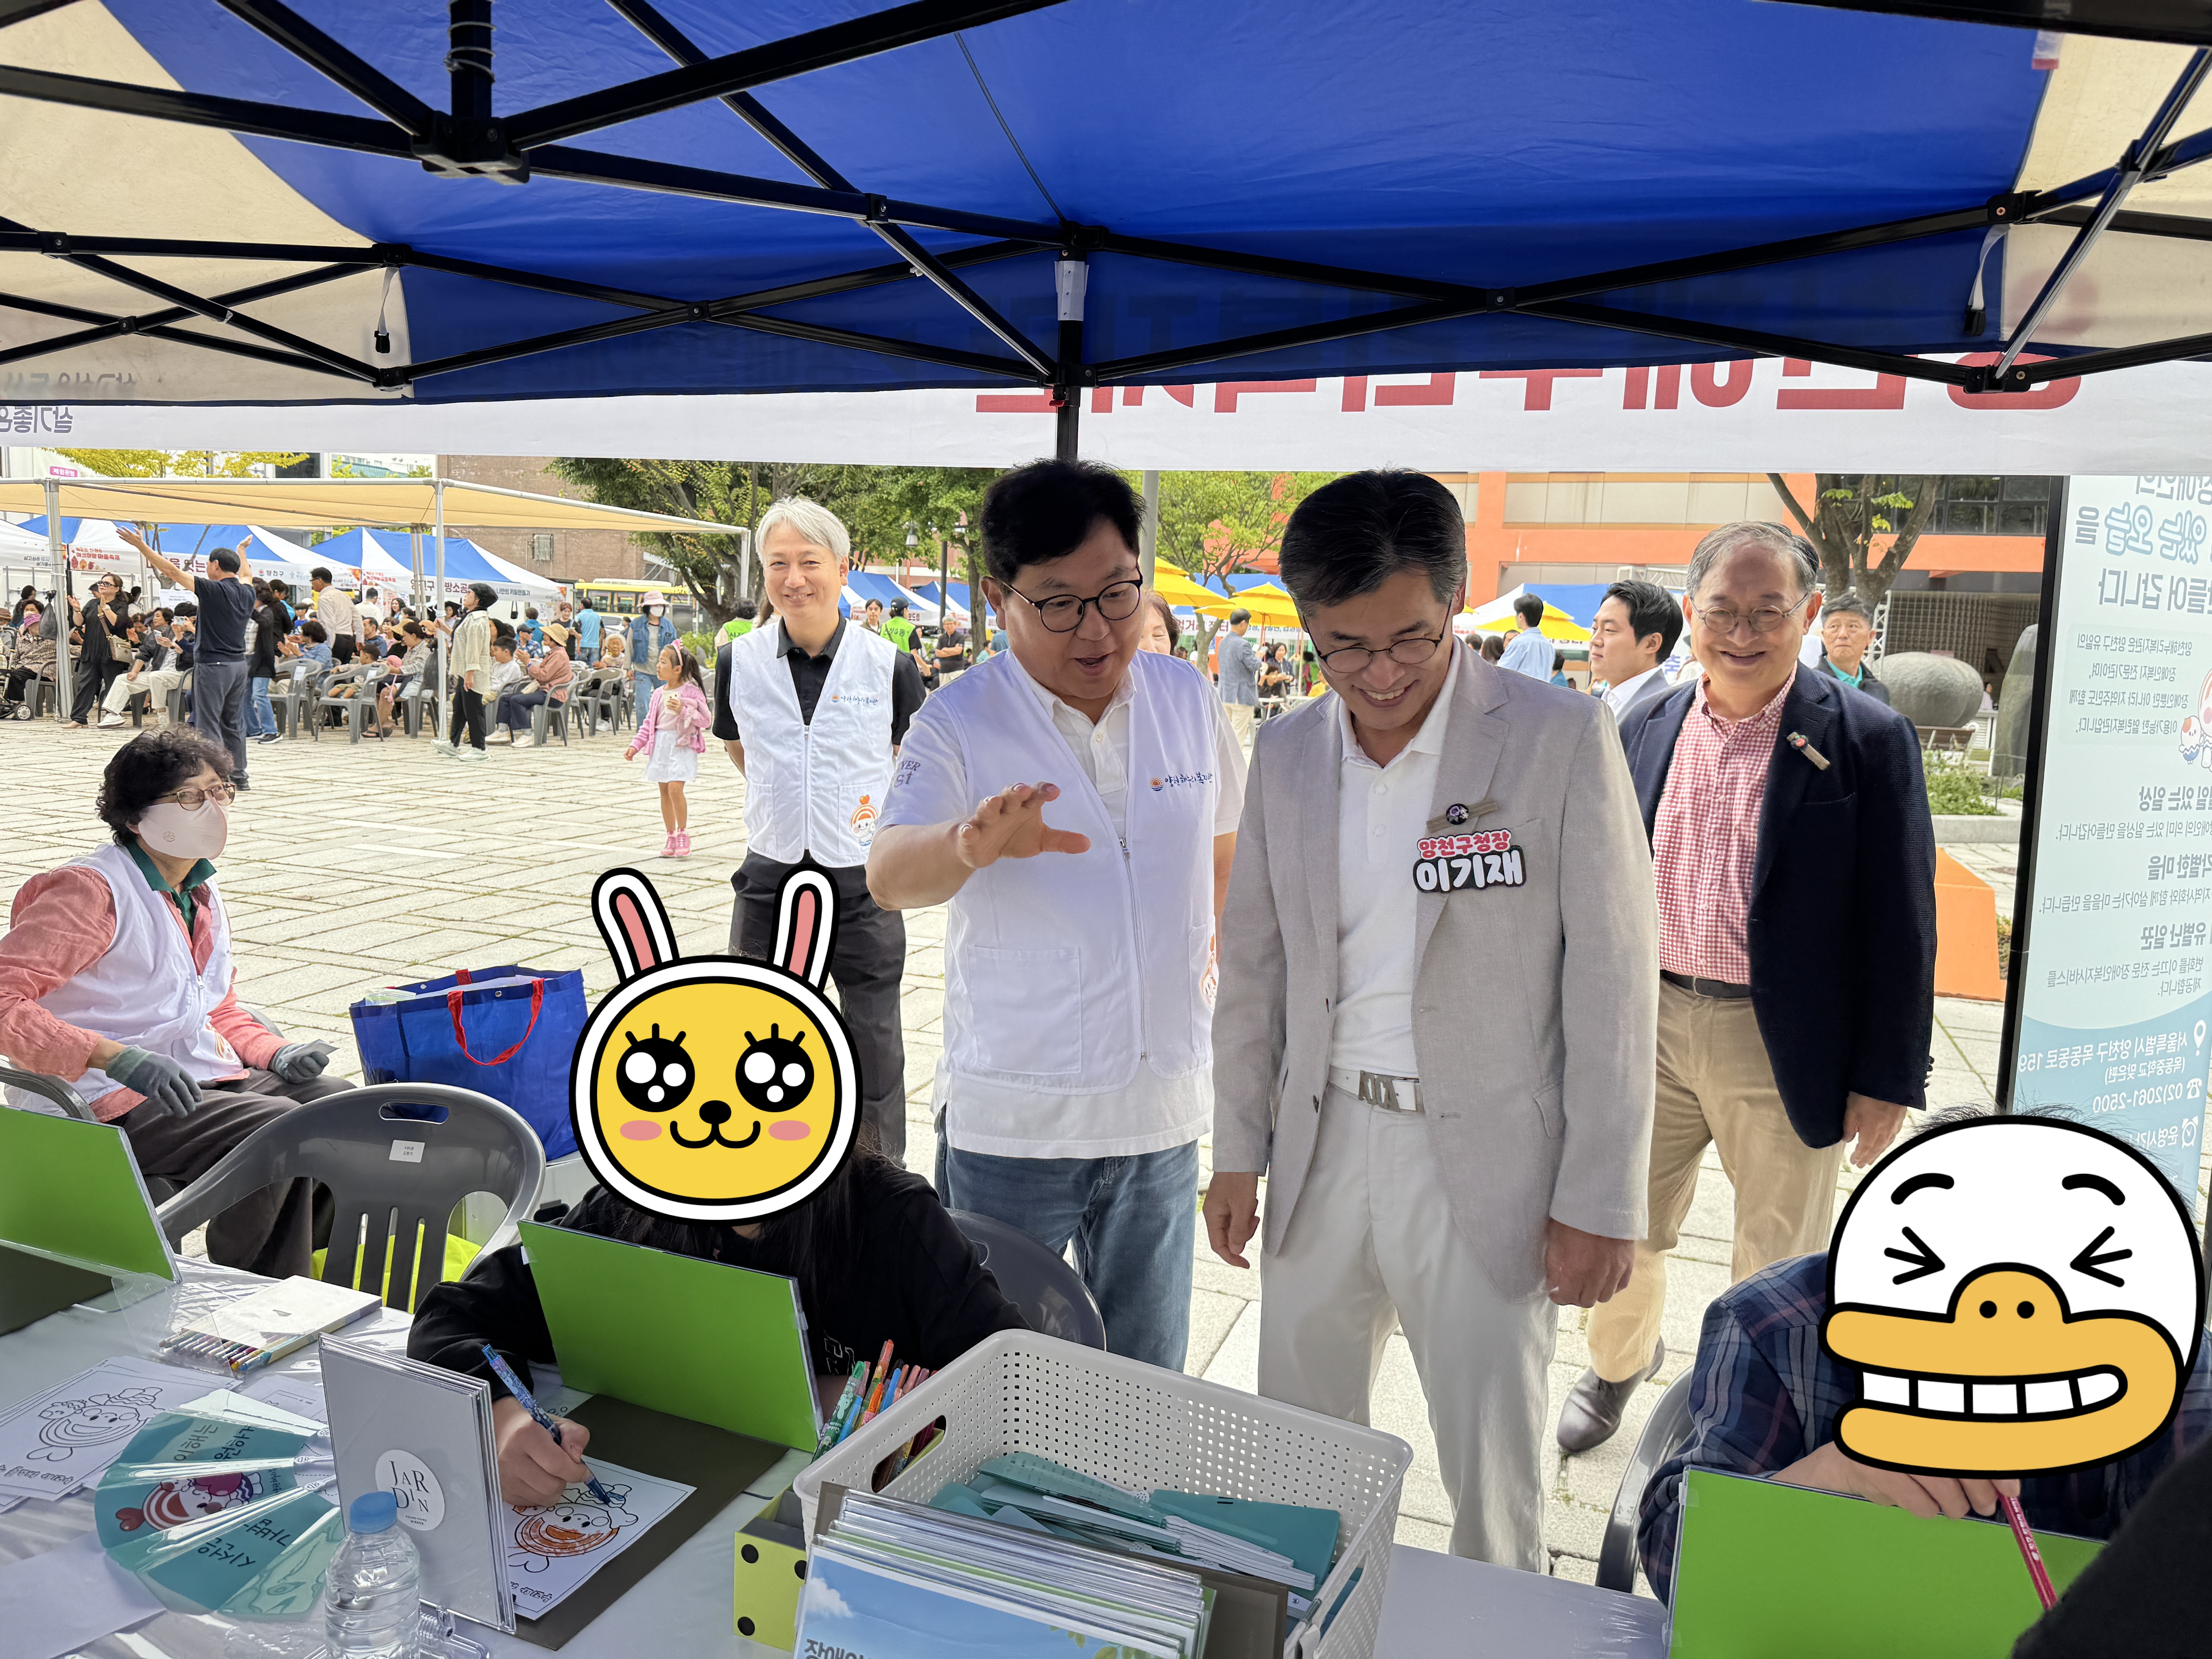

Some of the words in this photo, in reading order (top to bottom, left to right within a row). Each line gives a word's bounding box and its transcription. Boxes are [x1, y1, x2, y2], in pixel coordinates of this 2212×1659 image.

[1419, 831, 1510, 859] 양천구청장
[1416, 850, 1523, 891] 이기재
[243, 1518, 291, 1547] 가볍
